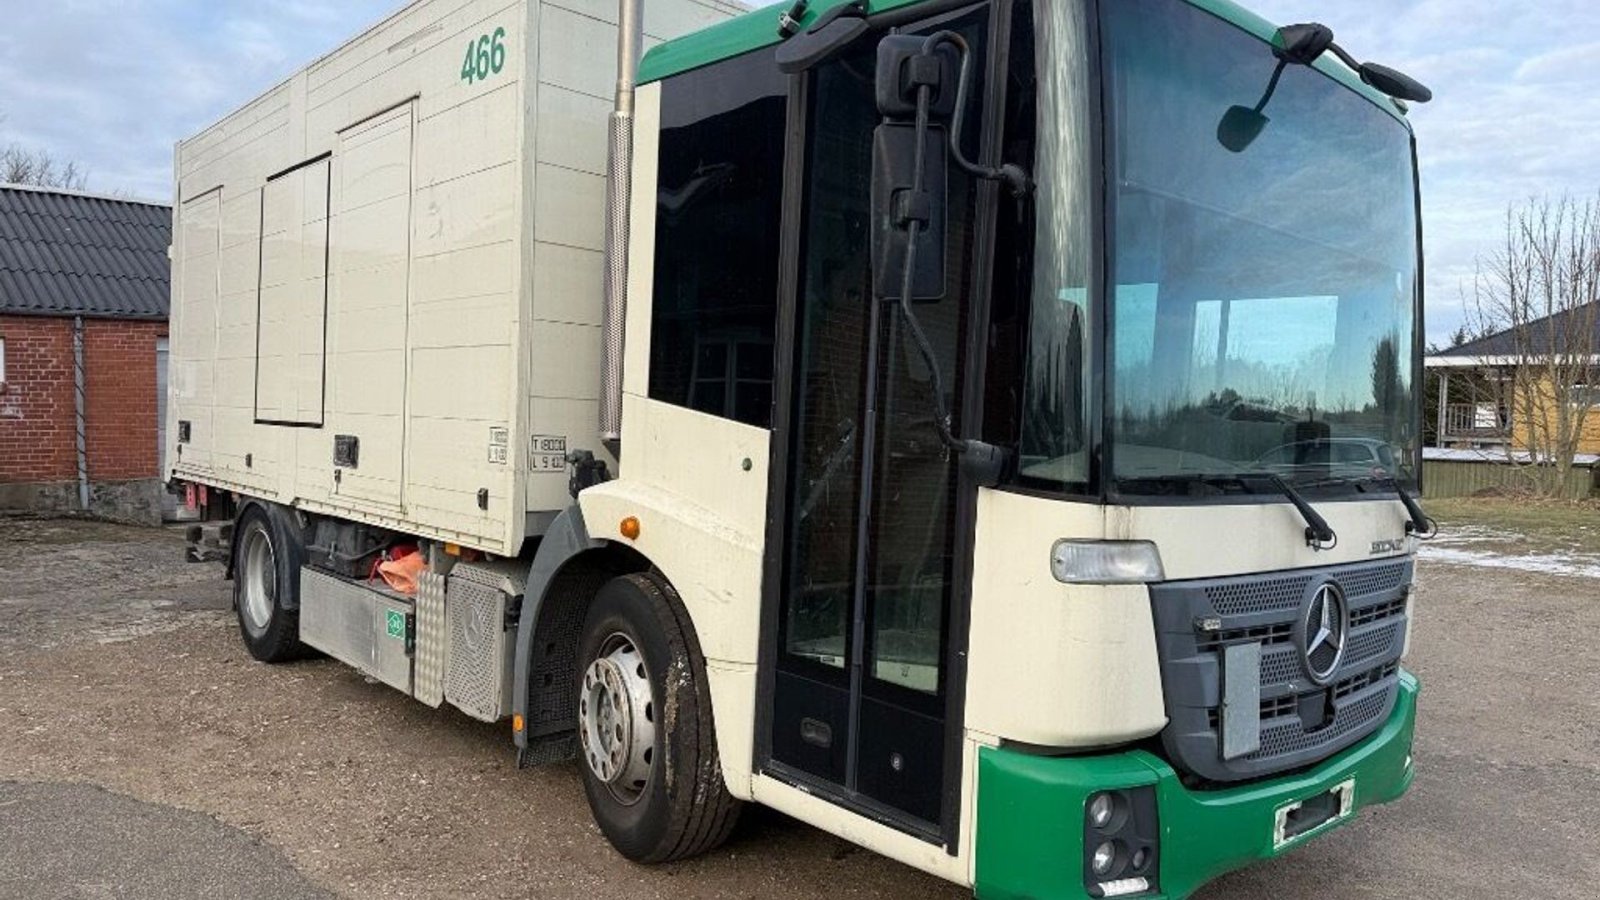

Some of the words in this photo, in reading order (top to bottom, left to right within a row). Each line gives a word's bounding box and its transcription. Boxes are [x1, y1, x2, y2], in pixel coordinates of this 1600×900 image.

[461, 26, 505, 85] 466
[534, 439, 538, 450] T
[533, 456, 537, 468] L
